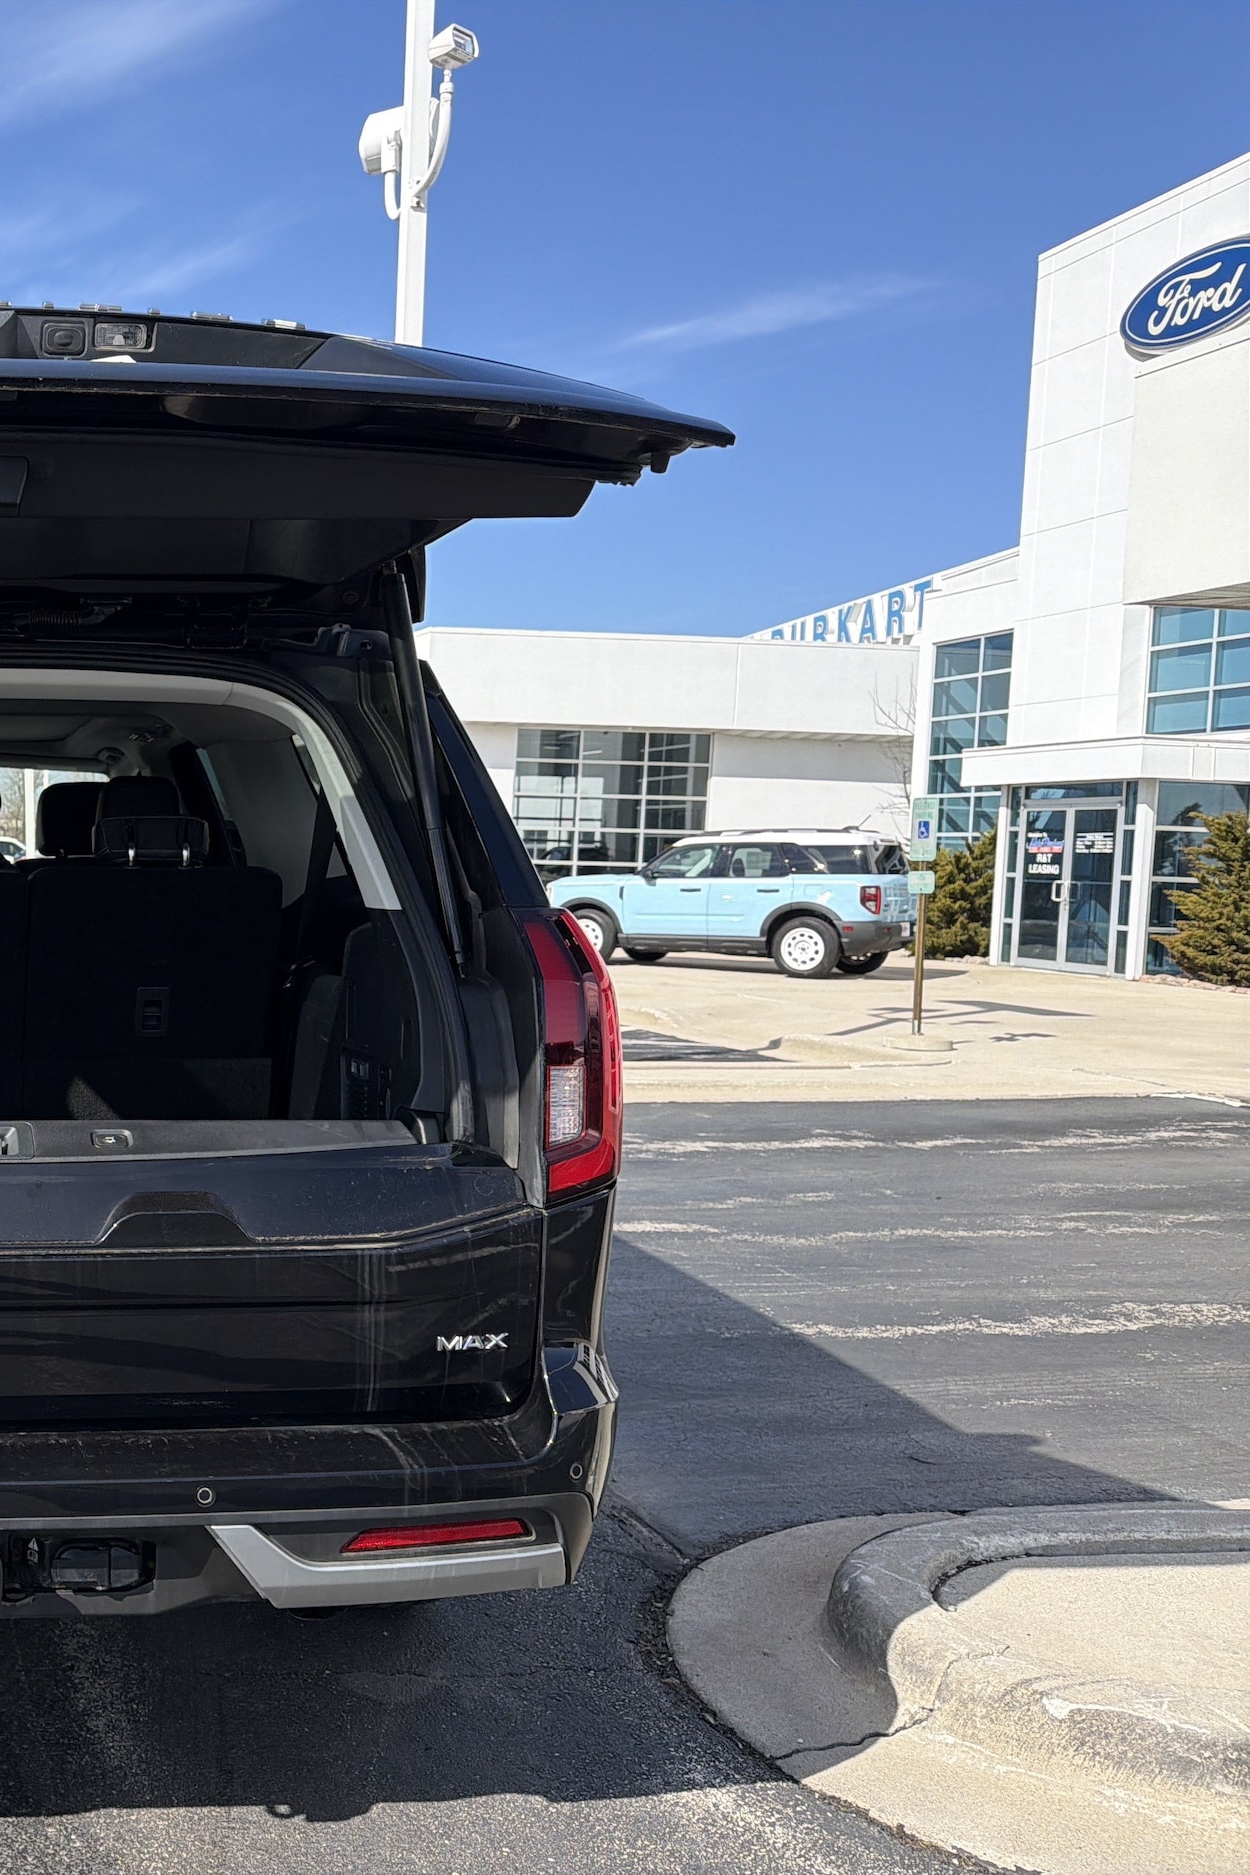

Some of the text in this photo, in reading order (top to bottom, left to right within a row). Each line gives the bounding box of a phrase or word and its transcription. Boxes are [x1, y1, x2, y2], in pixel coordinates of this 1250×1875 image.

[1147, 261, 1247, 336] Ford
[1036, 853, 1053, 863] R&T
[1027, 863, 1060, 875] LEASING
[436, 1332, 509, 1352] MAX
